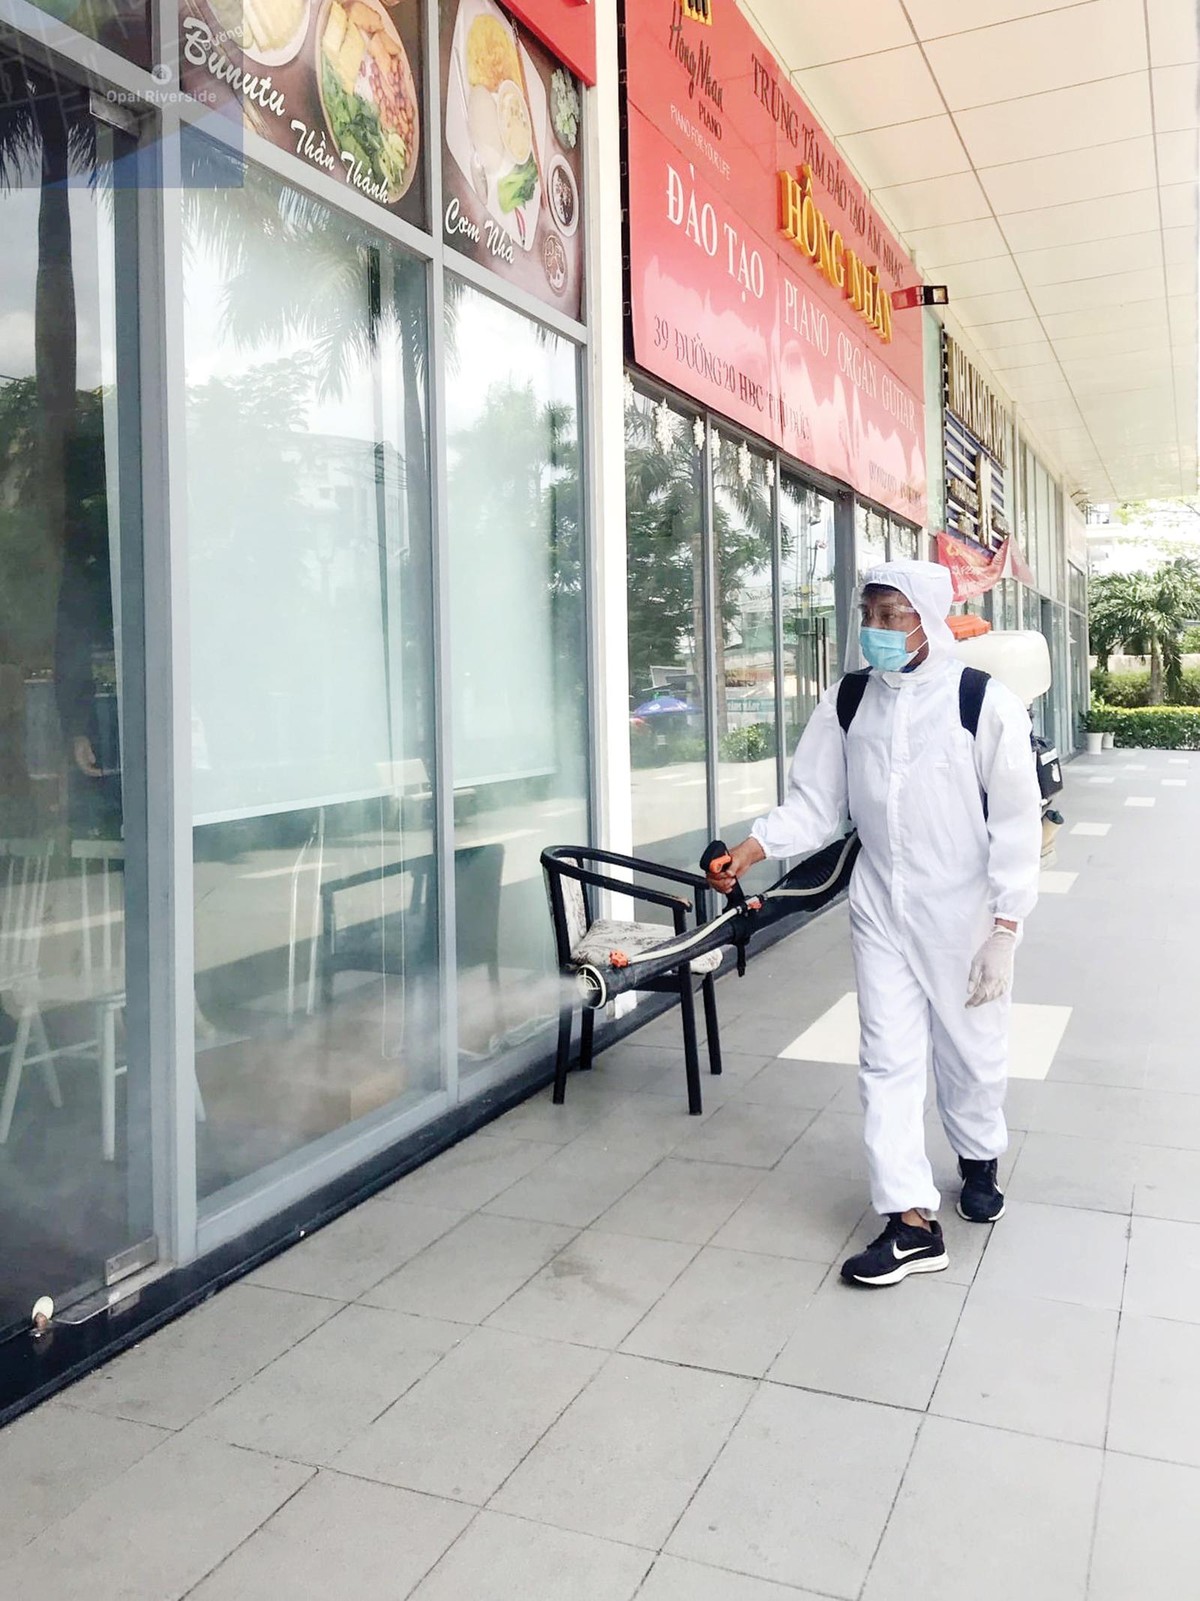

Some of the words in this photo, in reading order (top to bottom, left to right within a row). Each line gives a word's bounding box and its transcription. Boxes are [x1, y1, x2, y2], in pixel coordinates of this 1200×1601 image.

[290, 119, 335, 171] Thần
[340, 150, 389, 204] Thánh
[670, 103, 691, 137] PIANO
[698, 100, 722, 140] PIANO
[751, 53, 799, 148] TRUNG
[801, 123, 826, 187] TÂM
[826, 159, 847, 211] ĐÀO
[445, 197, 481, 243] Cơm
[484, 219, 515, 264] Nhà
[666, 162, 718, 257] ĐÀO
[723, 222, 765, 303] TẠO
[654, 315, 669, 351] 39
[674, 328, 722, 387] ĐƯỜNG
[722, 361, 736, 393] 20
[738, 372, 765, 412] HBC
[784, 277, 829, 357] PIANO
[837, 331, 877, 400] ORGAN
[881, 374, 917, 434] GUITAR
